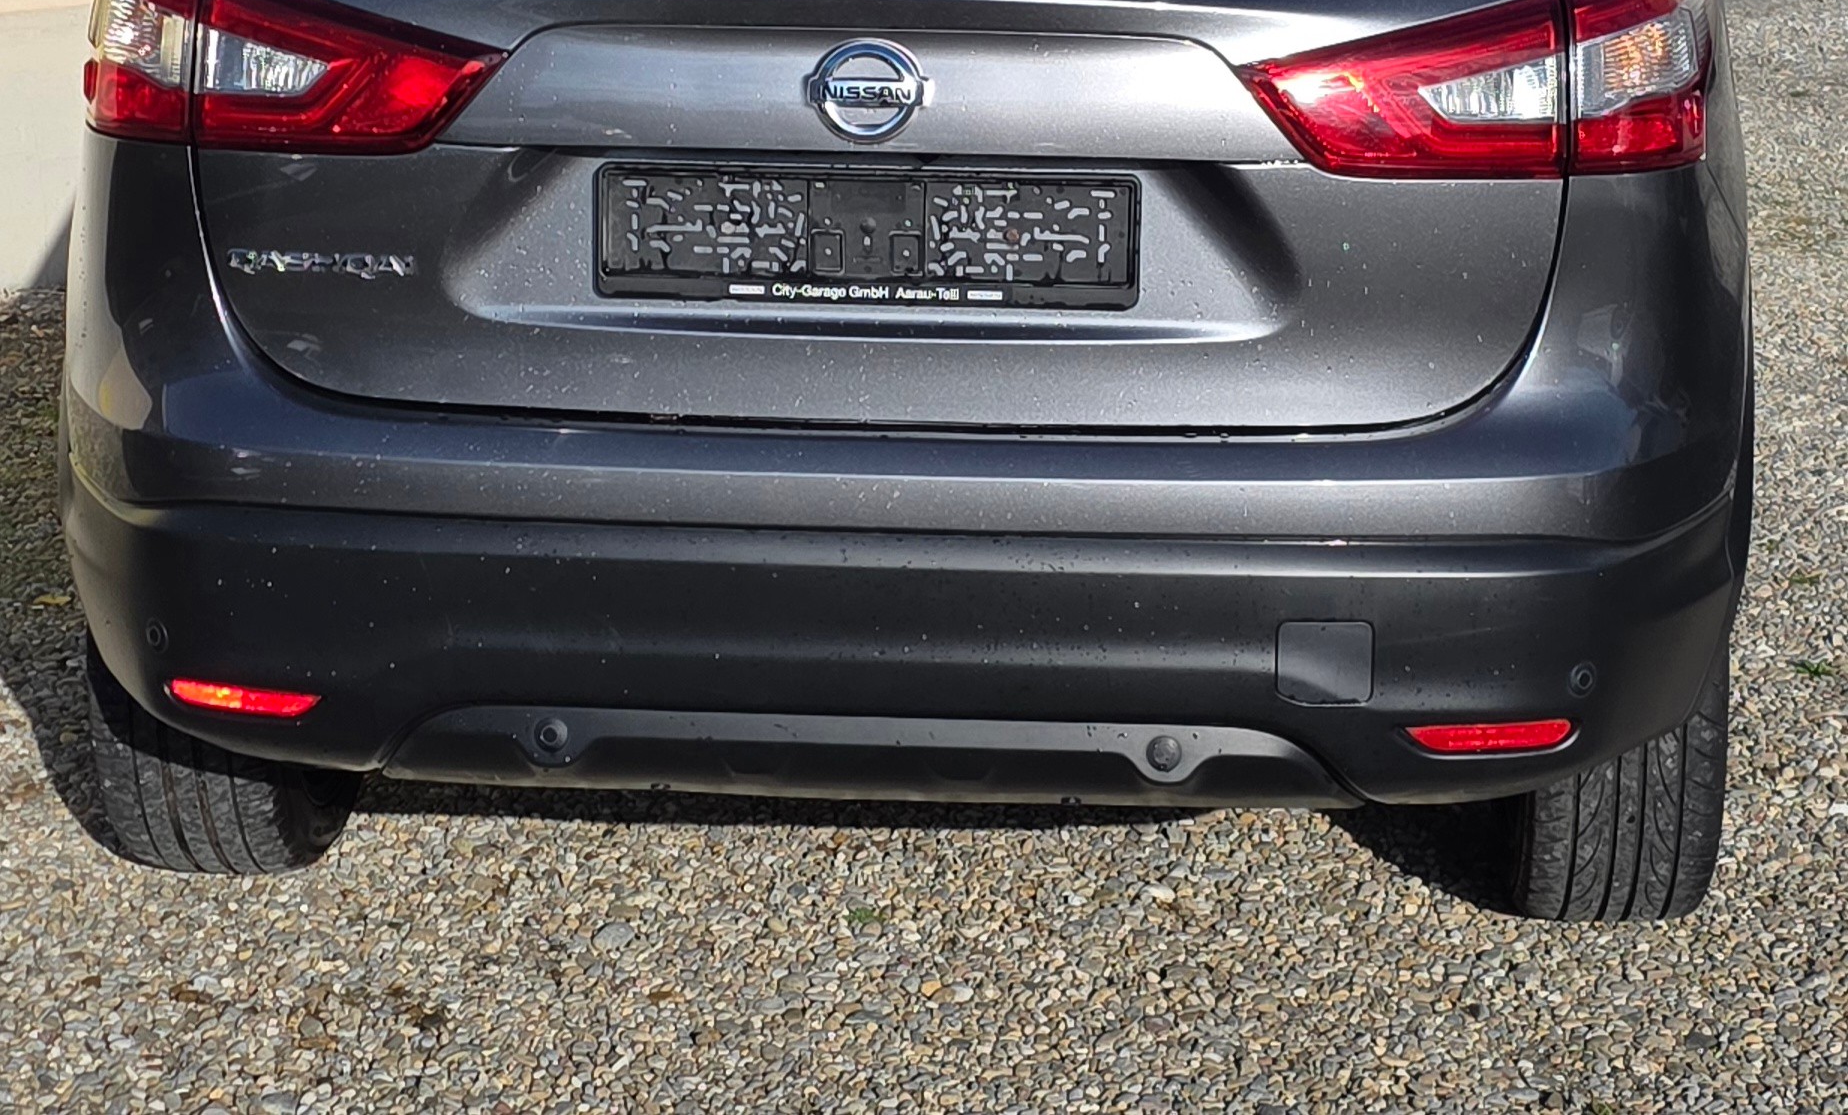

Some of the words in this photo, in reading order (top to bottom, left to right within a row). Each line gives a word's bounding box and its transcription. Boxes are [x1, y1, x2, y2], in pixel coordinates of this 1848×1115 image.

[821, 85, 911, 101] NISSAN
[227, 248, 415, 280] QASHQAI
[771, 282, 847, 301] City-Garage
[848, 285, 889, 299] GmbH
